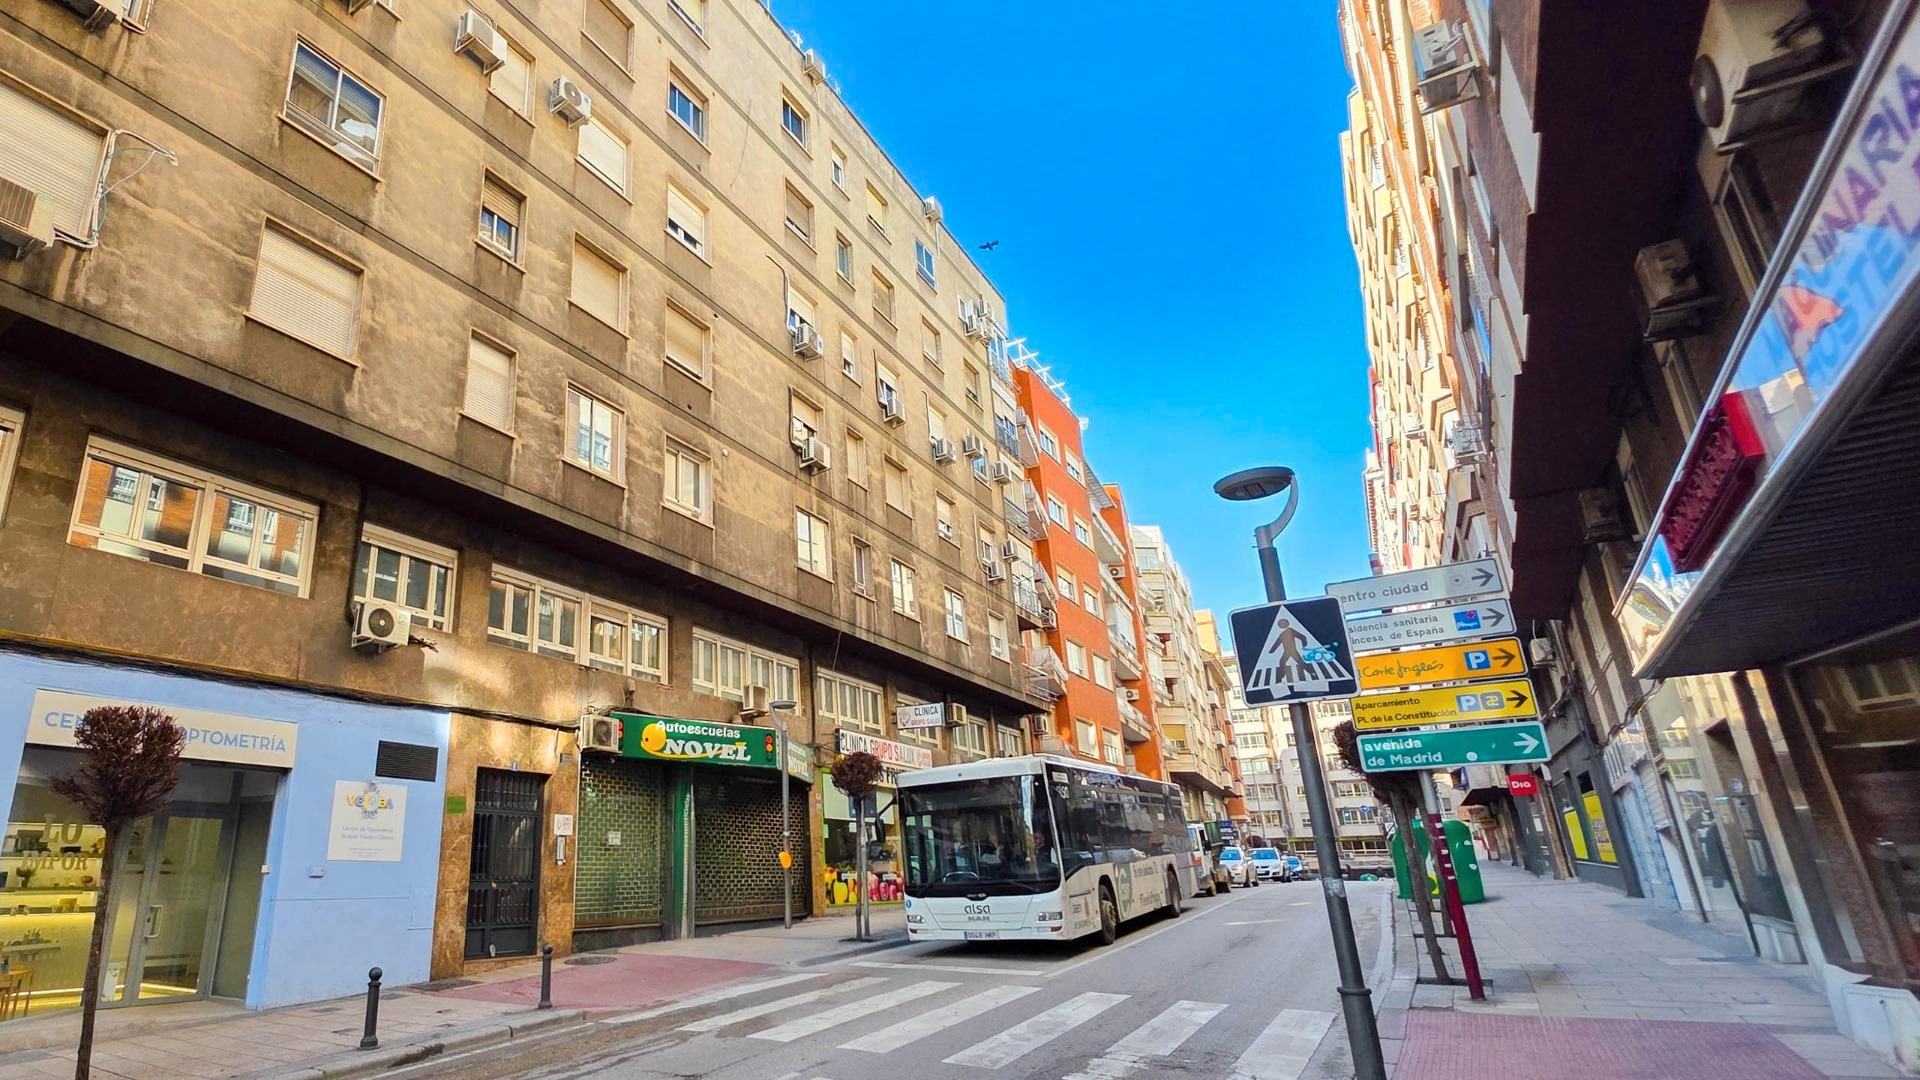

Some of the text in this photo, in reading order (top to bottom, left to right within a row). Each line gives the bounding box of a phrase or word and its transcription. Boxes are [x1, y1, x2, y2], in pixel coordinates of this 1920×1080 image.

[1341, 581, 1429, 603] entro ciudad
[1347, 615, 1439, 634] sidencia sanitaria
[1351, 634, 1384, 645] incesa
[1390, 632, 1402, 641] de
[1362, 664, 1395, 678] Corte
[914, 705, 939, 716] CLINICA
[1355, 697, 1421, 711] Aparcamiento
[1371, 715, 1383, 723] de
[1384, 714, 1393, 722] la
[1395, 709, 1457, 721] Constitución
[656, 720, 741, 739] Autoescuelas
[840, 732, 869, 753] CLINICA
[1364, 738, 1423, 752] avenida
[662, 739, 751, 762] NOVEL
[1367, 751, 1443, 767] de Madrid
[1511, 781, 1532, 789] Dia
[964, 904, 991, 914] alsa
